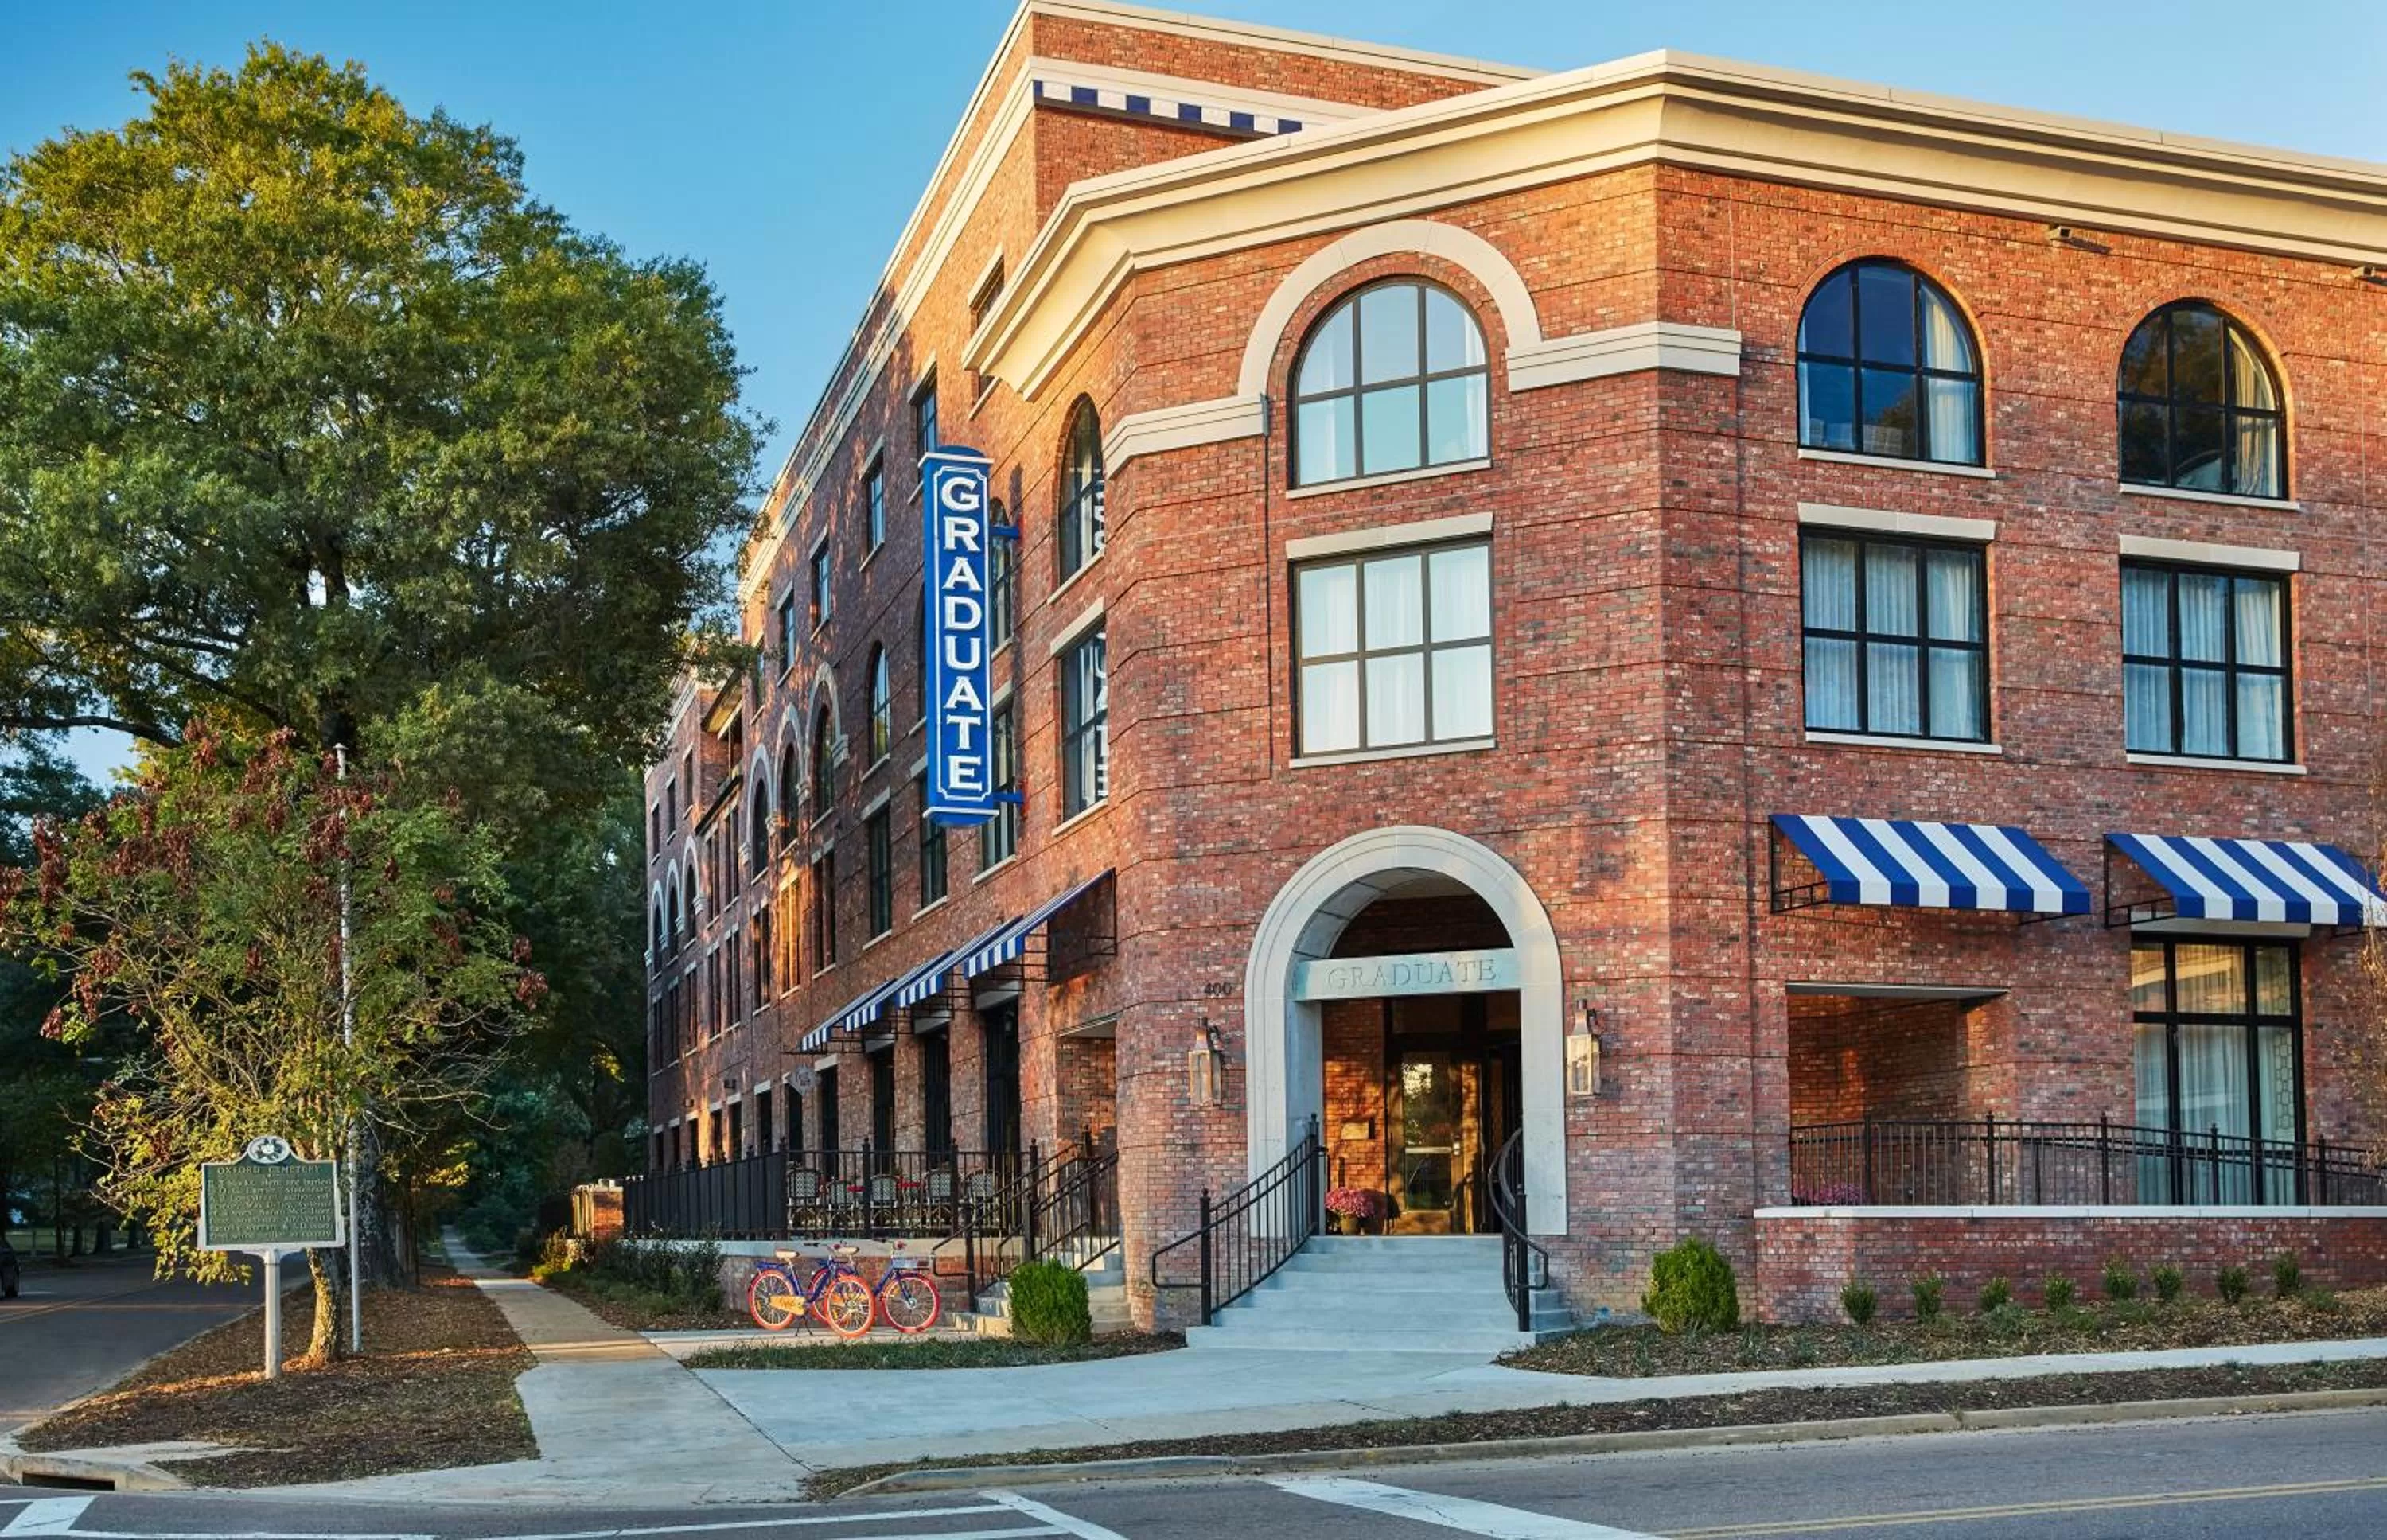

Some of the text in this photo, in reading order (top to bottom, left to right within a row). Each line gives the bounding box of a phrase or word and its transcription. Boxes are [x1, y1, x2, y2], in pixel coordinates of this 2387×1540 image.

[940, 477, 985, 791] GRADUATE
[1204, 982, 1233, 997] 400
[1326, 959, 1497, 990] GRADUATE
